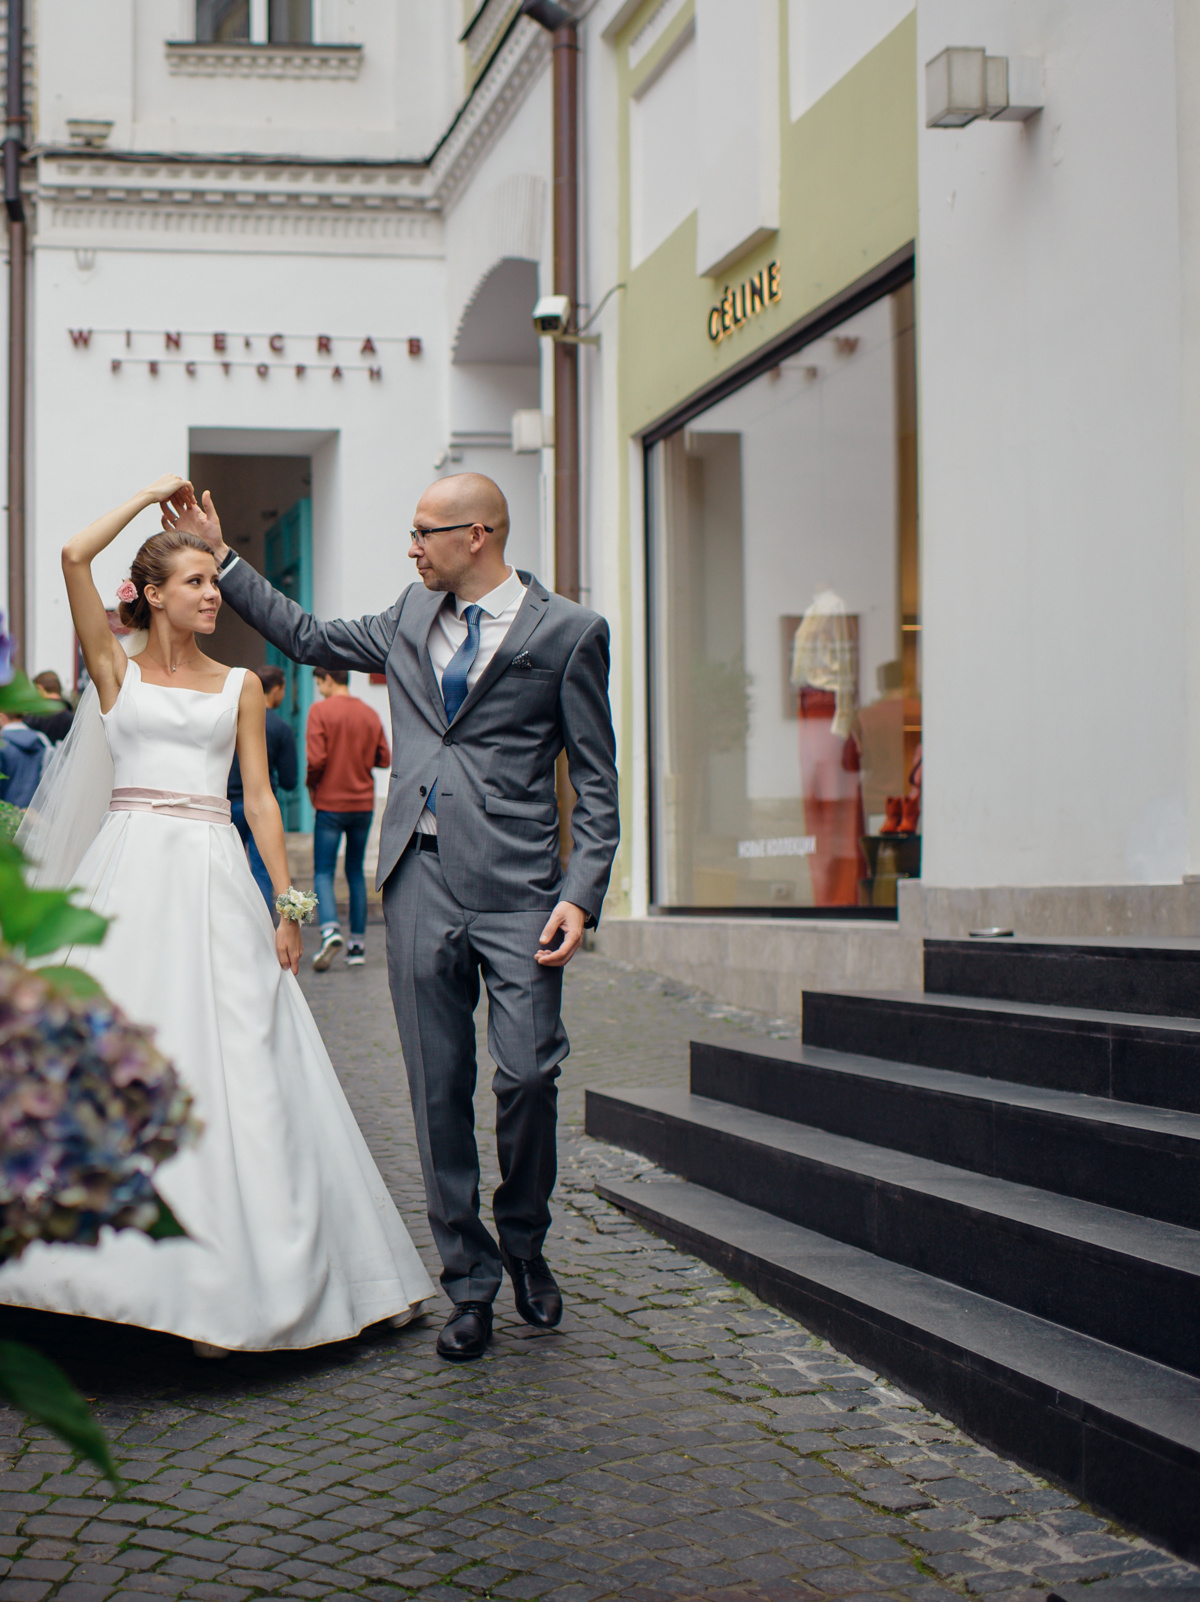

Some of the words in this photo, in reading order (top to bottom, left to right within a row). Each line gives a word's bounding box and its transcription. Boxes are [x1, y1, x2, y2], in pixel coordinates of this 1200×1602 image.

[708, 260, 781, 341] CÉLINE
[68, 328, 226, 352] WINE
[269, 333, 422, 356] CRAB
